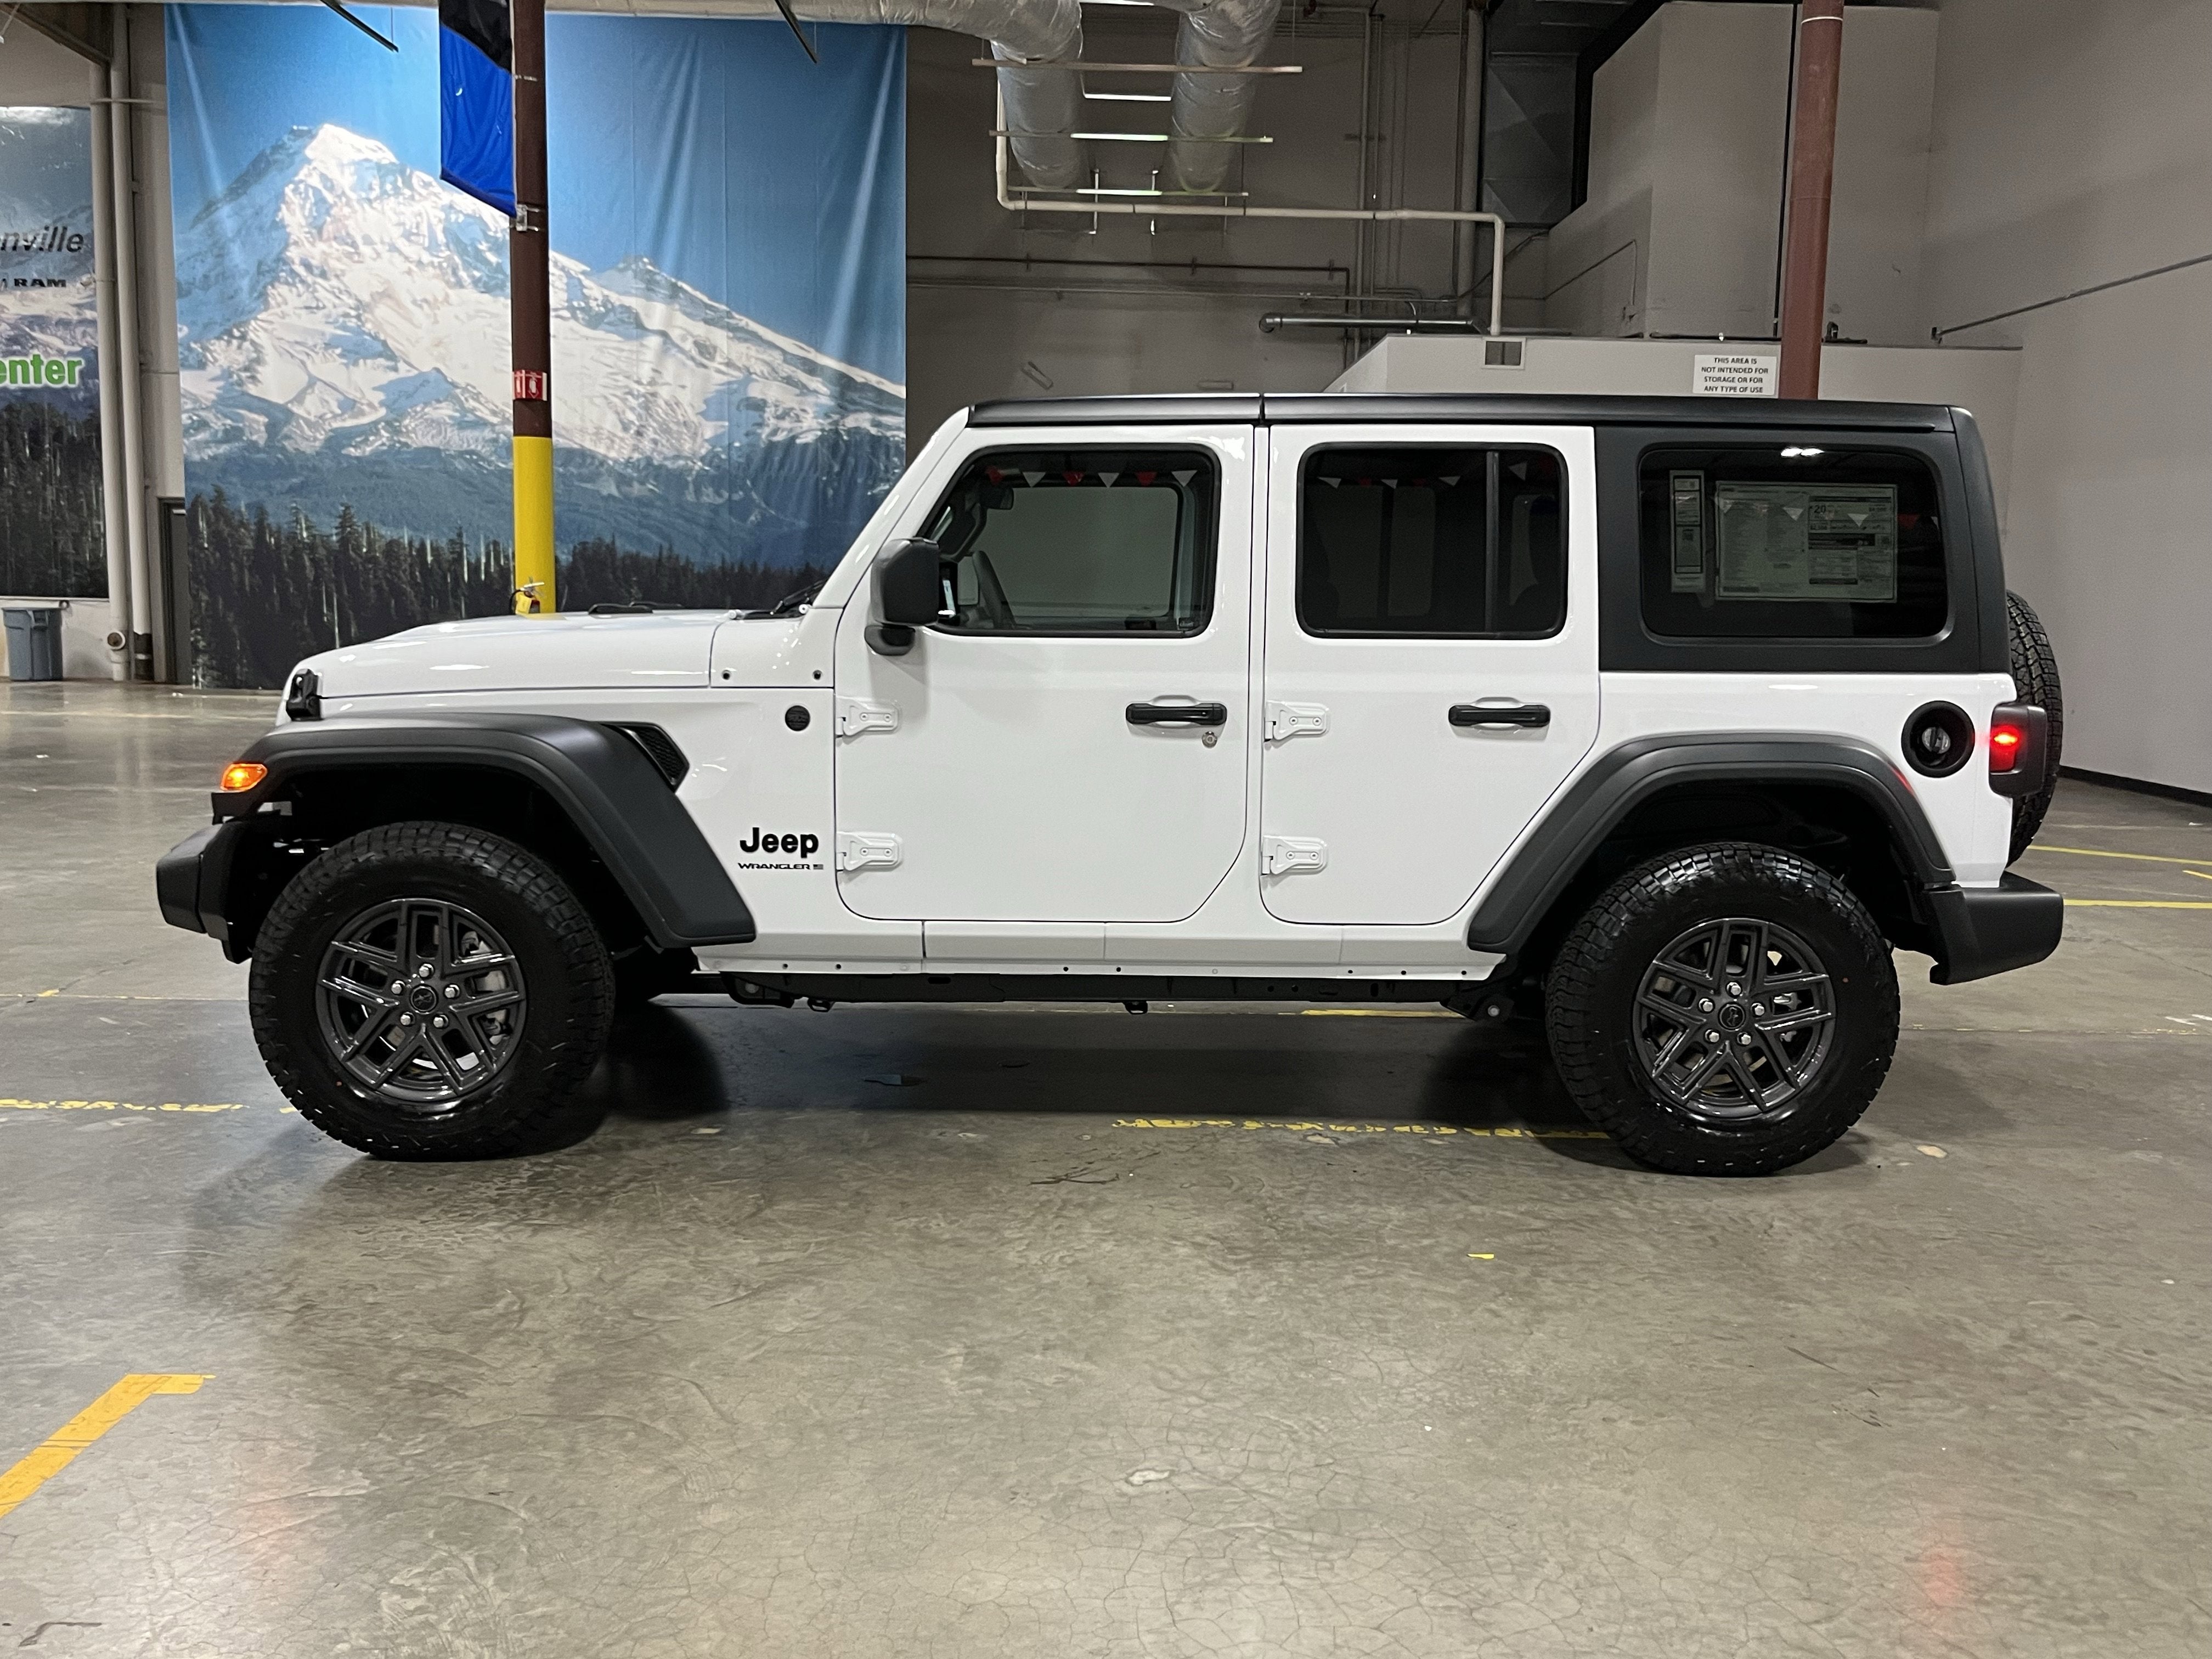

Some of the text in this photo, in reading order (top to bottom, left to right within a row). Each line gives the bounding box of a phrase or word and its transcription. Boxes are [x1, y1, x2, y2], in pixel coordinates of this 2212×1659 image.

[0, 225, 84, 252] nville
[14, 278, 66, 288] RAM
[740, 827, 819, 859] Jeep
